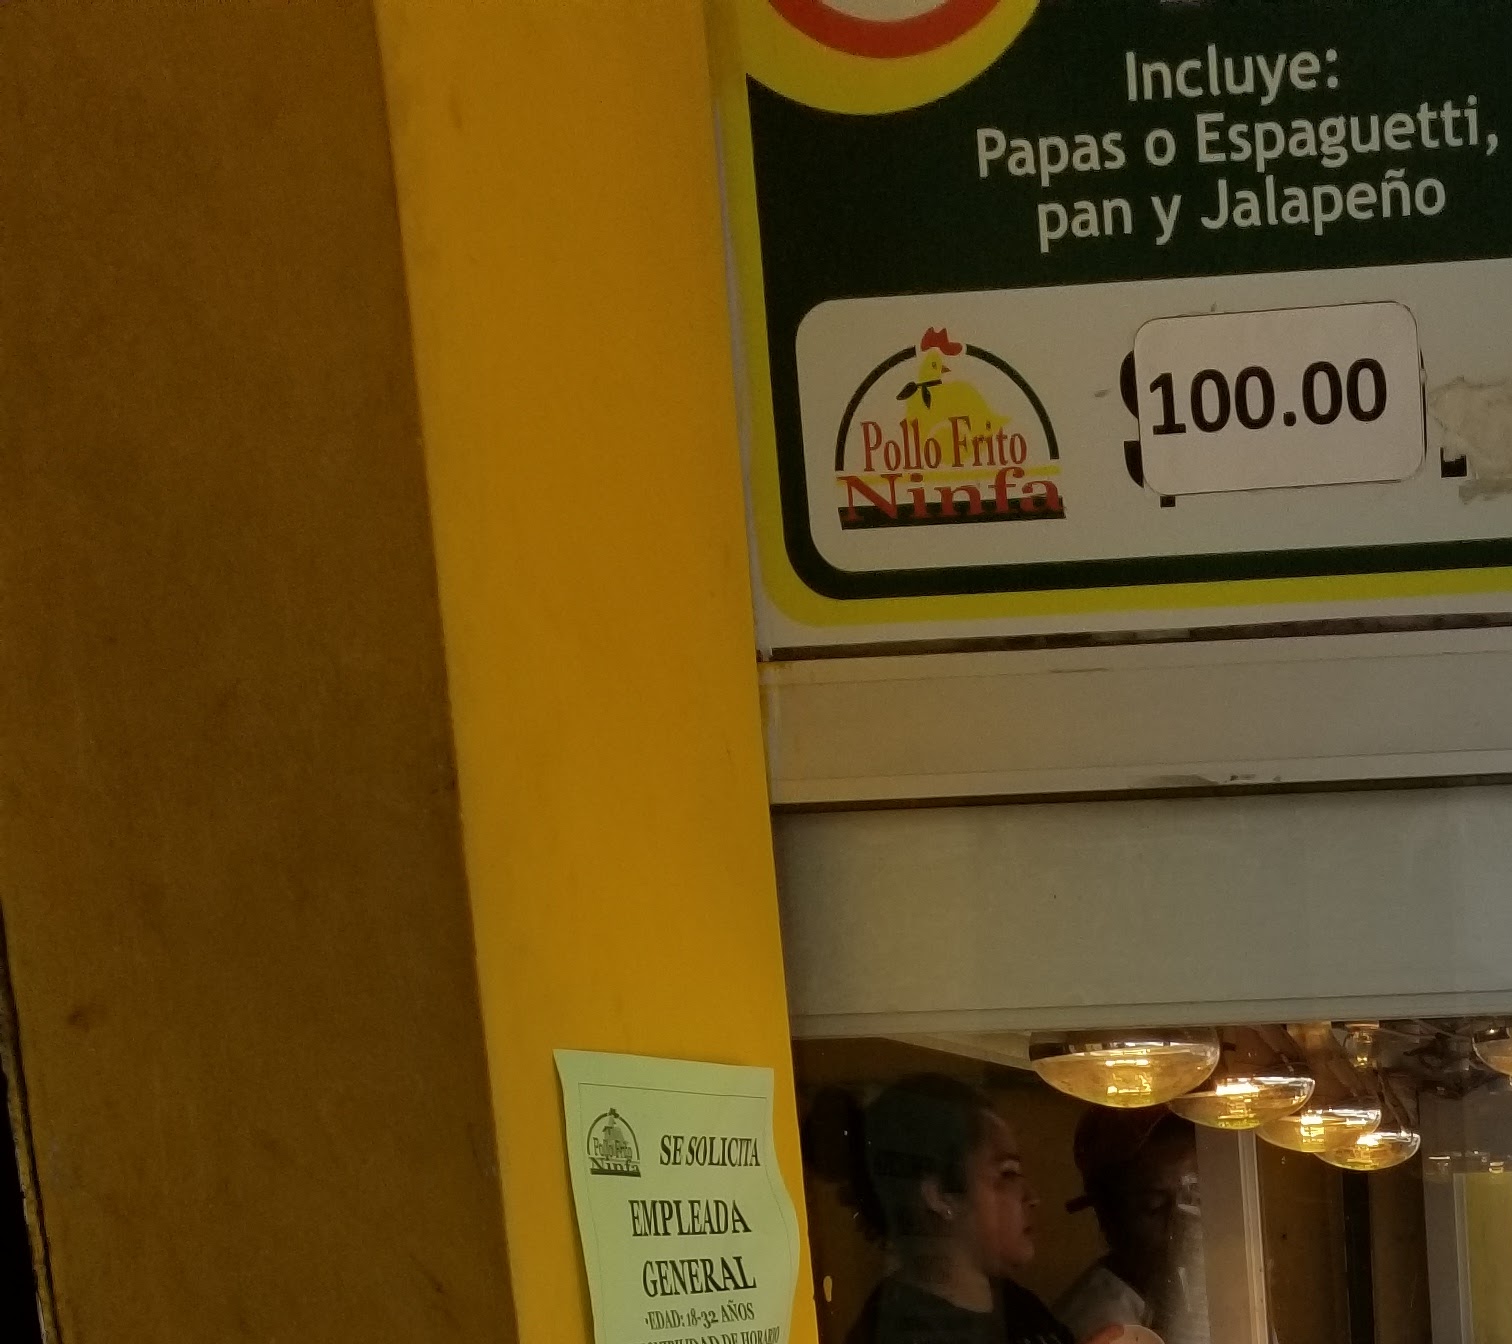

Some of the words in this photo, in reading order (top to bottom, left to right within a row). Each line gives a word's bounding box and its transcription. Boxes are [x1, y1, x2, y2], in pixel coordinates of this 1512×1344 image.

[1124, 43, 1340, 105] Incluye:
[975, 126, 1127, 187] Papas
[1143, 128, 1177, 168] o
[1196, 94, 1500, 173] Espaguetti,
[1036, 197, 1133, 254] pan
[1151, 191, 1182, 247] y
[1200, 169, 1446, 236] Jalapeño
[1148, 357, 1388, 436] 100.00
[860, 417, 942, 472] Pollo
[948, 415, 1028, 467] Frito
[836, 466, 1064, 521] Ninfa
[659, 1134, 684, 1166] SE
[685, 1135, 761, 1167] SOLICITA
[628, 1199, 753, 1237] EMPLEADA
[642, 1256, 757, 1298] GENERAL
[687, 1307, 719, 1329] 18-32
[720, 1299, 755, 1323] AÑOS
